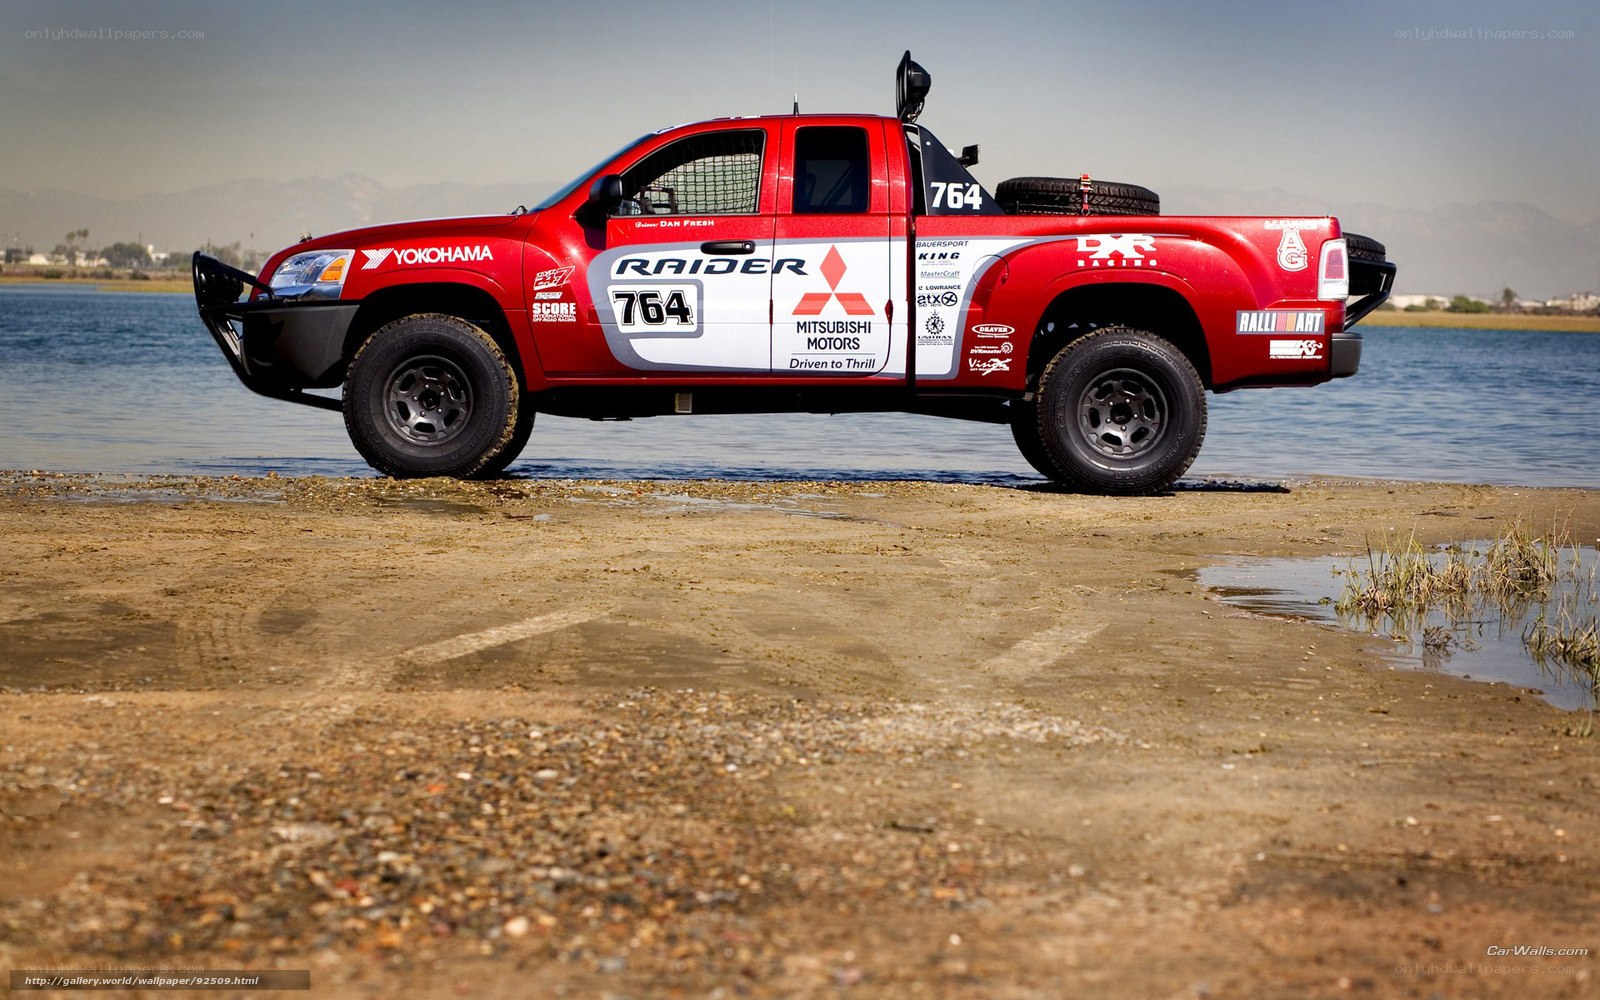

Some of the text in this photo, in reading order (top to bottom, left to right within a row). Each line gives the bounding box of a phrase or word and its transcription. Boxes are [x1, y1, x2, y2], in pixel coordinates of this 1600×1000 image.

[930, 181, 983, 210] 764
[683, 219, 715, 227] FRESH
[916, 240, 969, 248] BAUERSPORT
[393, 246, 494, 265] YOKOHAMA
[918, 251, 961, 260] KING
[615, 258, 809, 276] RAIDER
[1077, 259, 1158, 267] RACING
[532, 302, 577, 315] SCORE
[611, 289, 695, 326] 764
[796, 321, 872, 334] MITSUBISHI
[807, 337, 861, 350] MOTORS
[789, 358, 876, 369] Driven to Thrill
